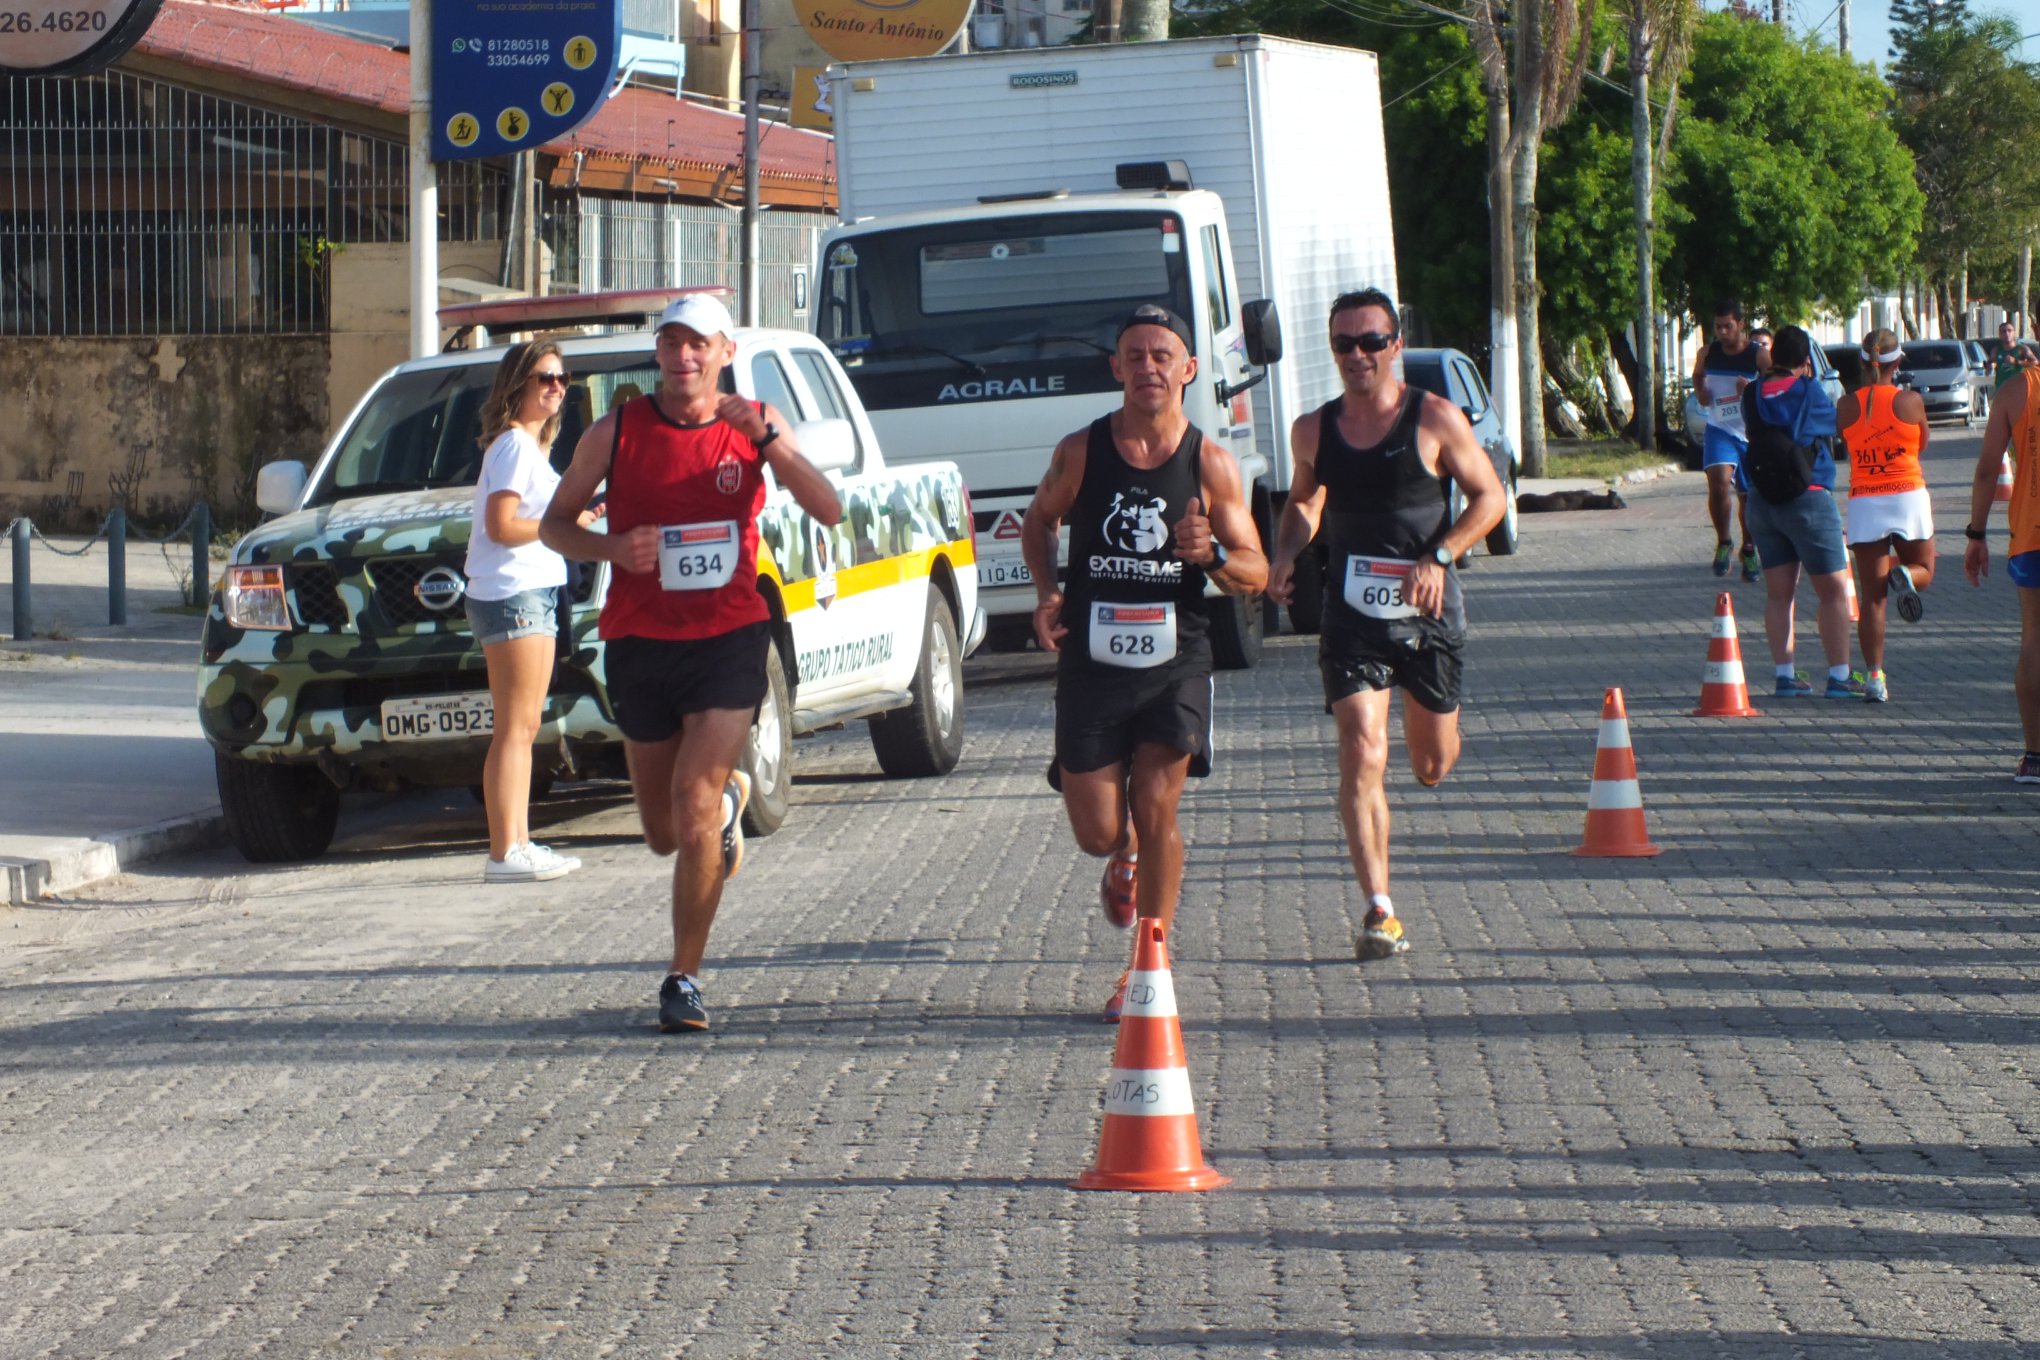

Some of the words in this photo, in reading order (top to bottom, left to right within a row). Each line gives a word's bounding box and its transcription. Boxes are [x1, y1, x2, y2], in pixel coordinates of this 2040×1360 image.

[810, 10, 865, 33] Santo
[869, 17, 945, 41] Antônio
[487, 39, 550, 51] 81280518
[487, 54, 550, 66] 33054699
[938, 375, 1066, 400] AGRALE
[1721, 405, 1738, 417] 203
[678, 553, 723, 577] 634
[1089, 555, 1183, 578] EXTREME
[418, 583, 457, 593] NISSAN
[1363, 586, 1404, 607] 603
[1109, 634, 1155, 655] 628
[799, 647, 831, 684] GRUPO
[865, 632, 894, 668] RURAL
[1107, 1079, 1159, 1104] OTAS
